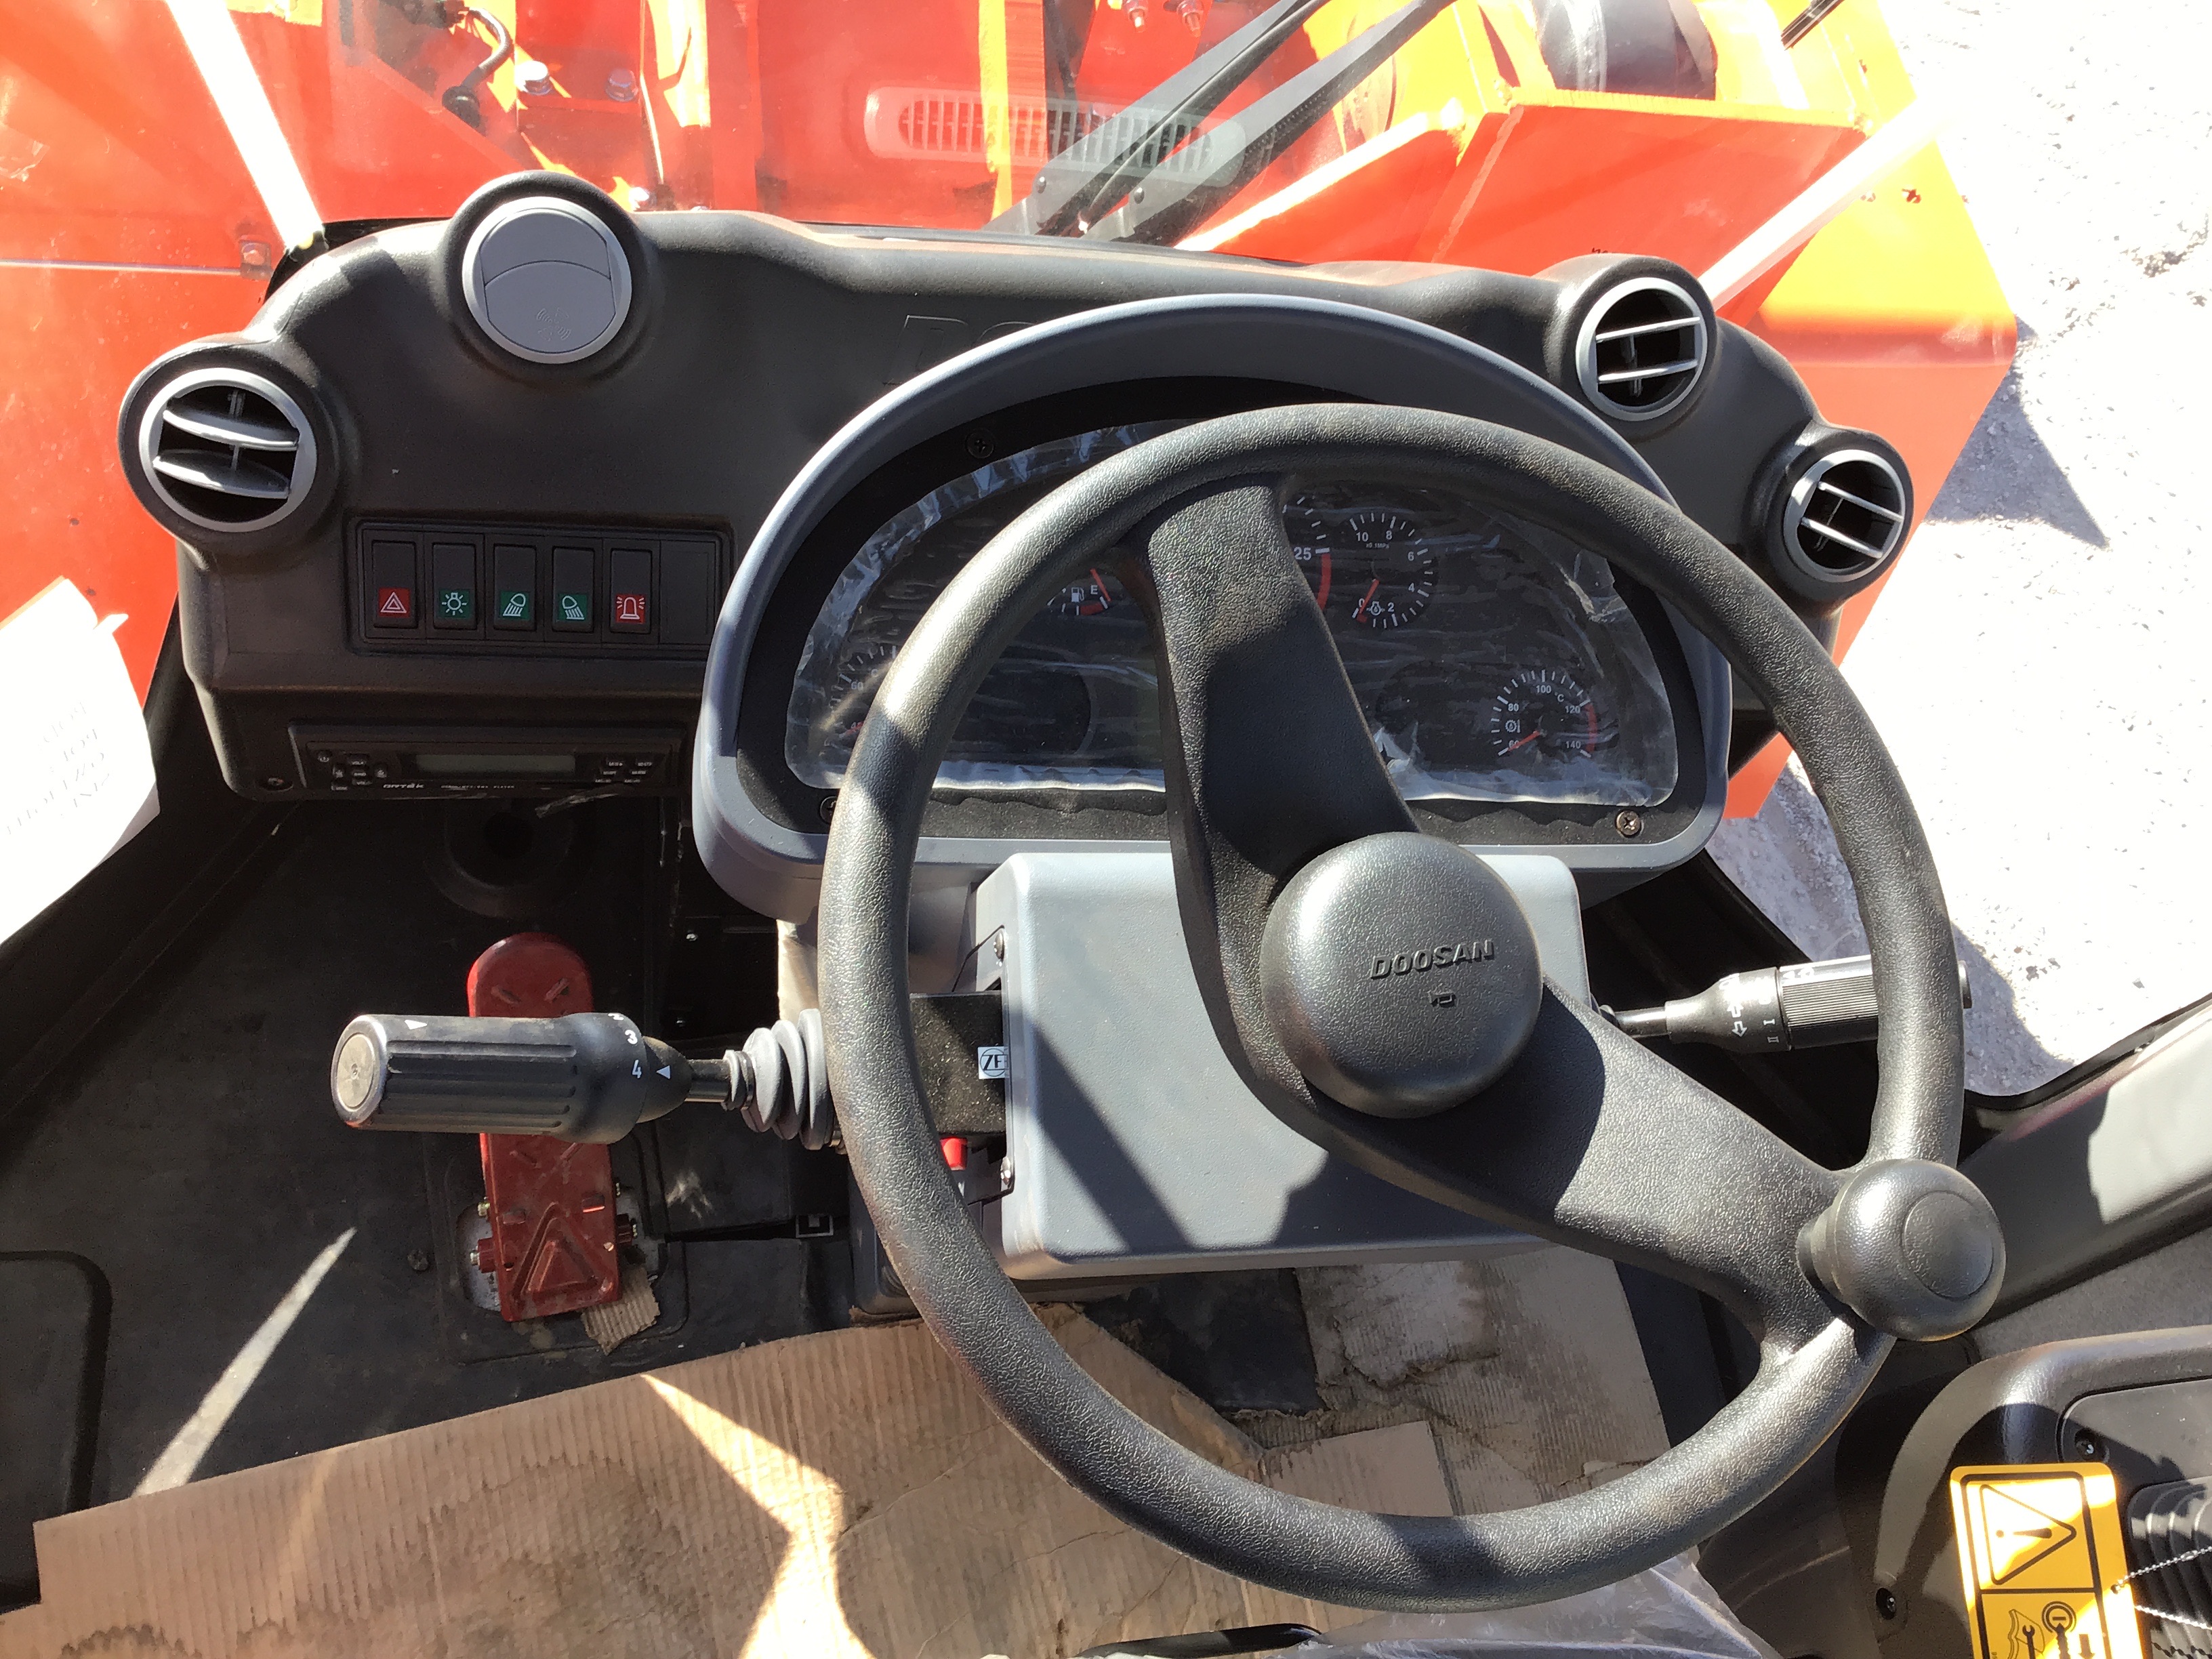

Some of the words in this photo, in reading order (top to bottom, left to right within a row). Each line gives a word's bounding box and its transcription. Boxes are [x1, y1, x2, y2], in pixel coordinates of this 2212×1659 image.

[1356, 532, 1369, 542] 10
[1386, 531, 1393, 540] 8
[1294, 547, 1311, 560] 25
[1408, 552, 1414, 561] 6
[1090, 584, 1098, 595] E
[1408, 583, 1414, 592] 4
[1387, 602, 1394, 612] 2
[851, 681, 863, 691] 60
[1536, 685, 1552, 694] 100
[1508, 703, 1519, 712] 80
[1565, 705, 1580, 714] 120
[1565, 741, 1581, 750] 140
[1370, 939, 1495, 979] DOOSAN
[624, 1029, 638, 1045] 3
[632, 1059, 642, 1079] 4
